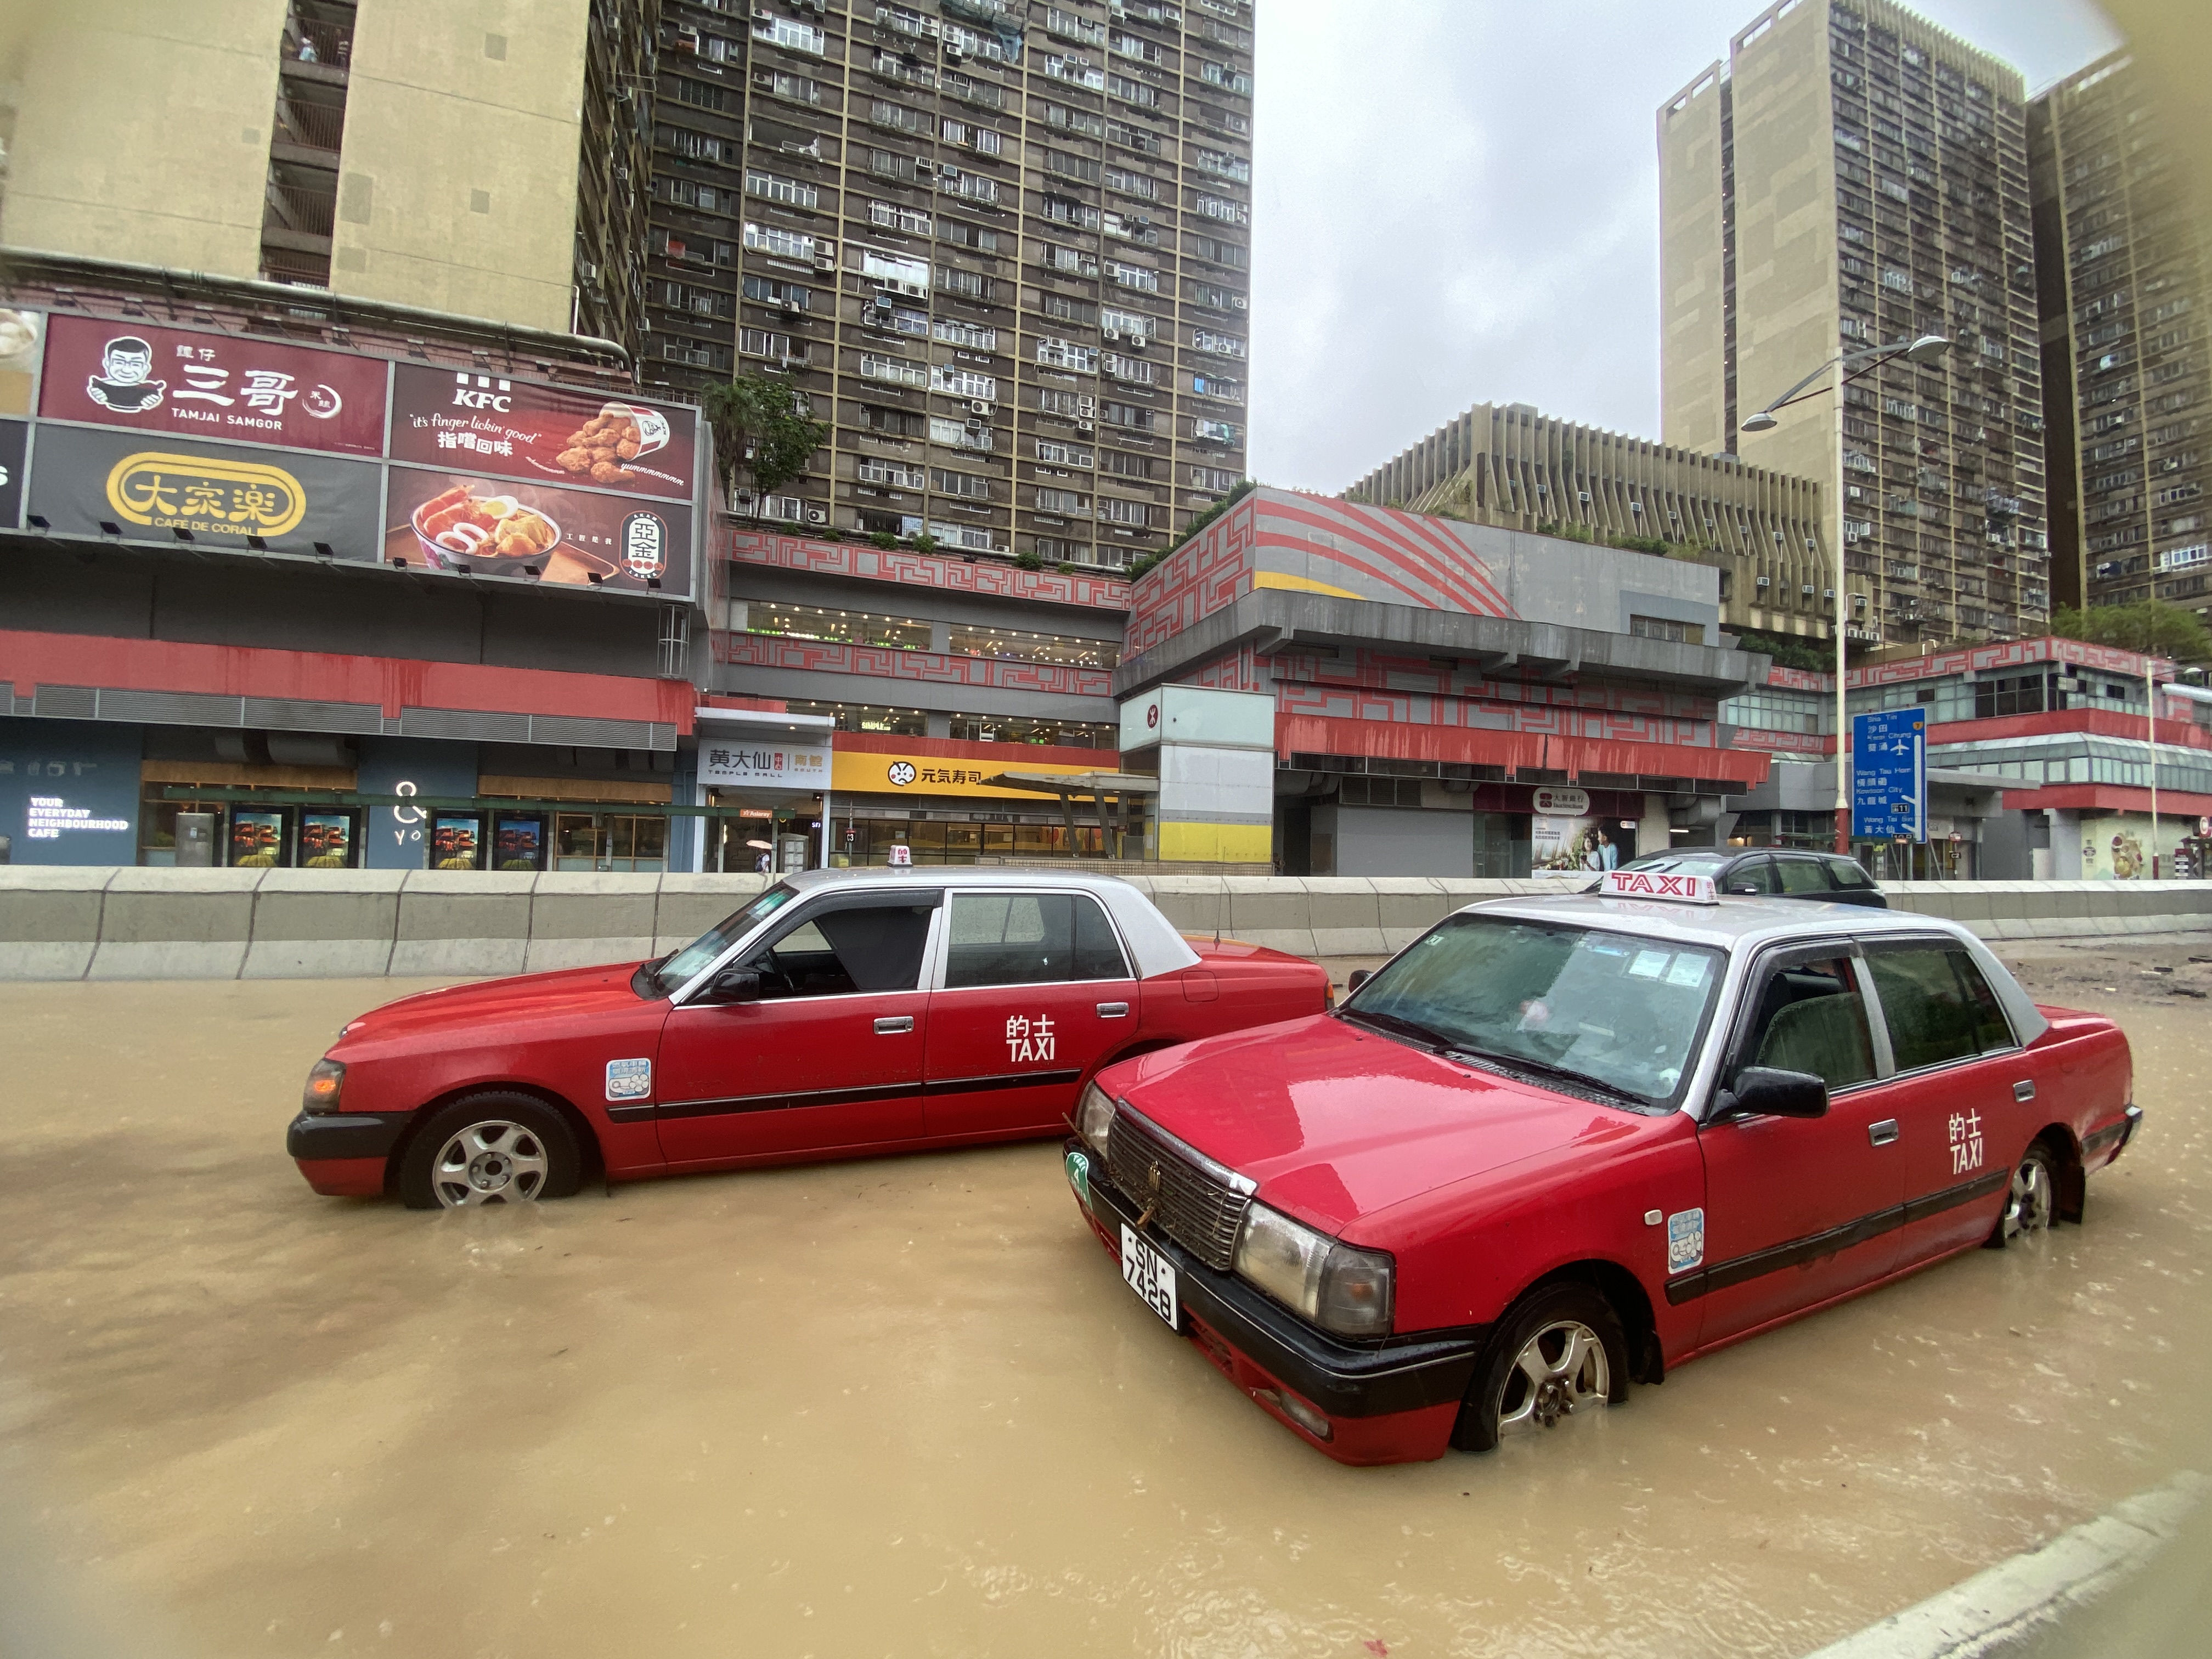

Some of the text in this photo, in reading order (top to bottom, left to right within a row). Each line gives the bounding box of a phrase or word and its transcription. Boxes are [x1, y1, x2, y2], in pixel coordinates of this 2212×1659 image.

[172, 364, 298, 416] 三哥
[452, 388, 511, 413] KFC
[171, 407, 283, 431] TAMJAI SAMGOR
[431, 413, 469, 431] finger
[191, 521, 208, 532] DE
[212, 523, 256, 536] CORAL
[633, 513, 658, 522] AKAM
[861, 721, 884, 730] SIMPLE
[29, 808, 91, 819] EVERYDAY
[31, 797, 64, 808] YOUR
[28, 828, 59, 838] CAFE
[29, 818, 129, 830] NEIGHBOURHOOD
[1612, 873, 1696, 897] TAXI
[1006, 1014, 1055, 1038] 的士
[1006, 1037, 1055, 1062] TAXI
[1949, 1108, 1982, 1143] 的士
[1950, 1137, 1983, 1175] TAXI
[1135, 1239, 1158, 1283] SN
[1125, 1255, 1171, 1322] 7428
